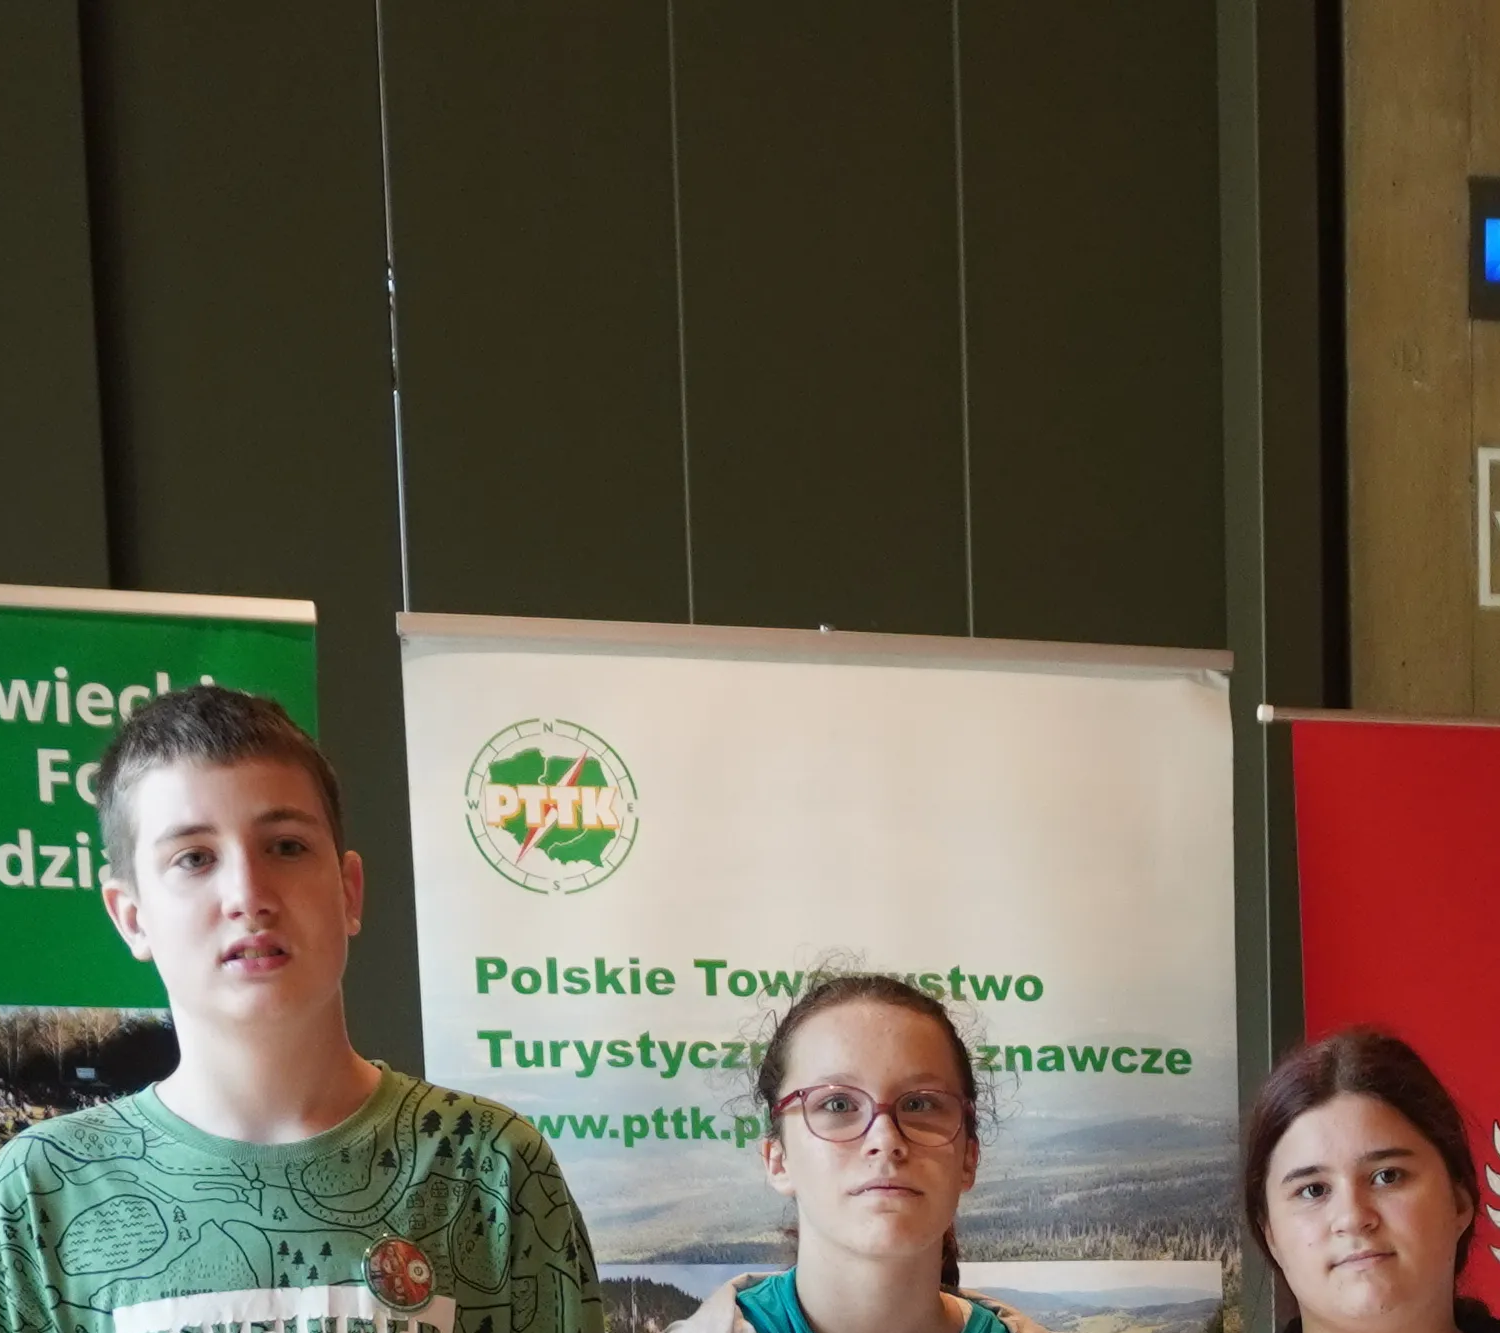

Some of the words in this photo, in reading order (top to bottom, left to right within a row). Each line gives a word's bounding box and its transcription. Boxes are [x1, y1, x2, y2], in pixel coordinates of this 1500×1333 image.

[484, 783, 620, 830] PTTK
[475, 956, 676, 996] Polskie
[975, 1043, 1193, 1077] znawcze
